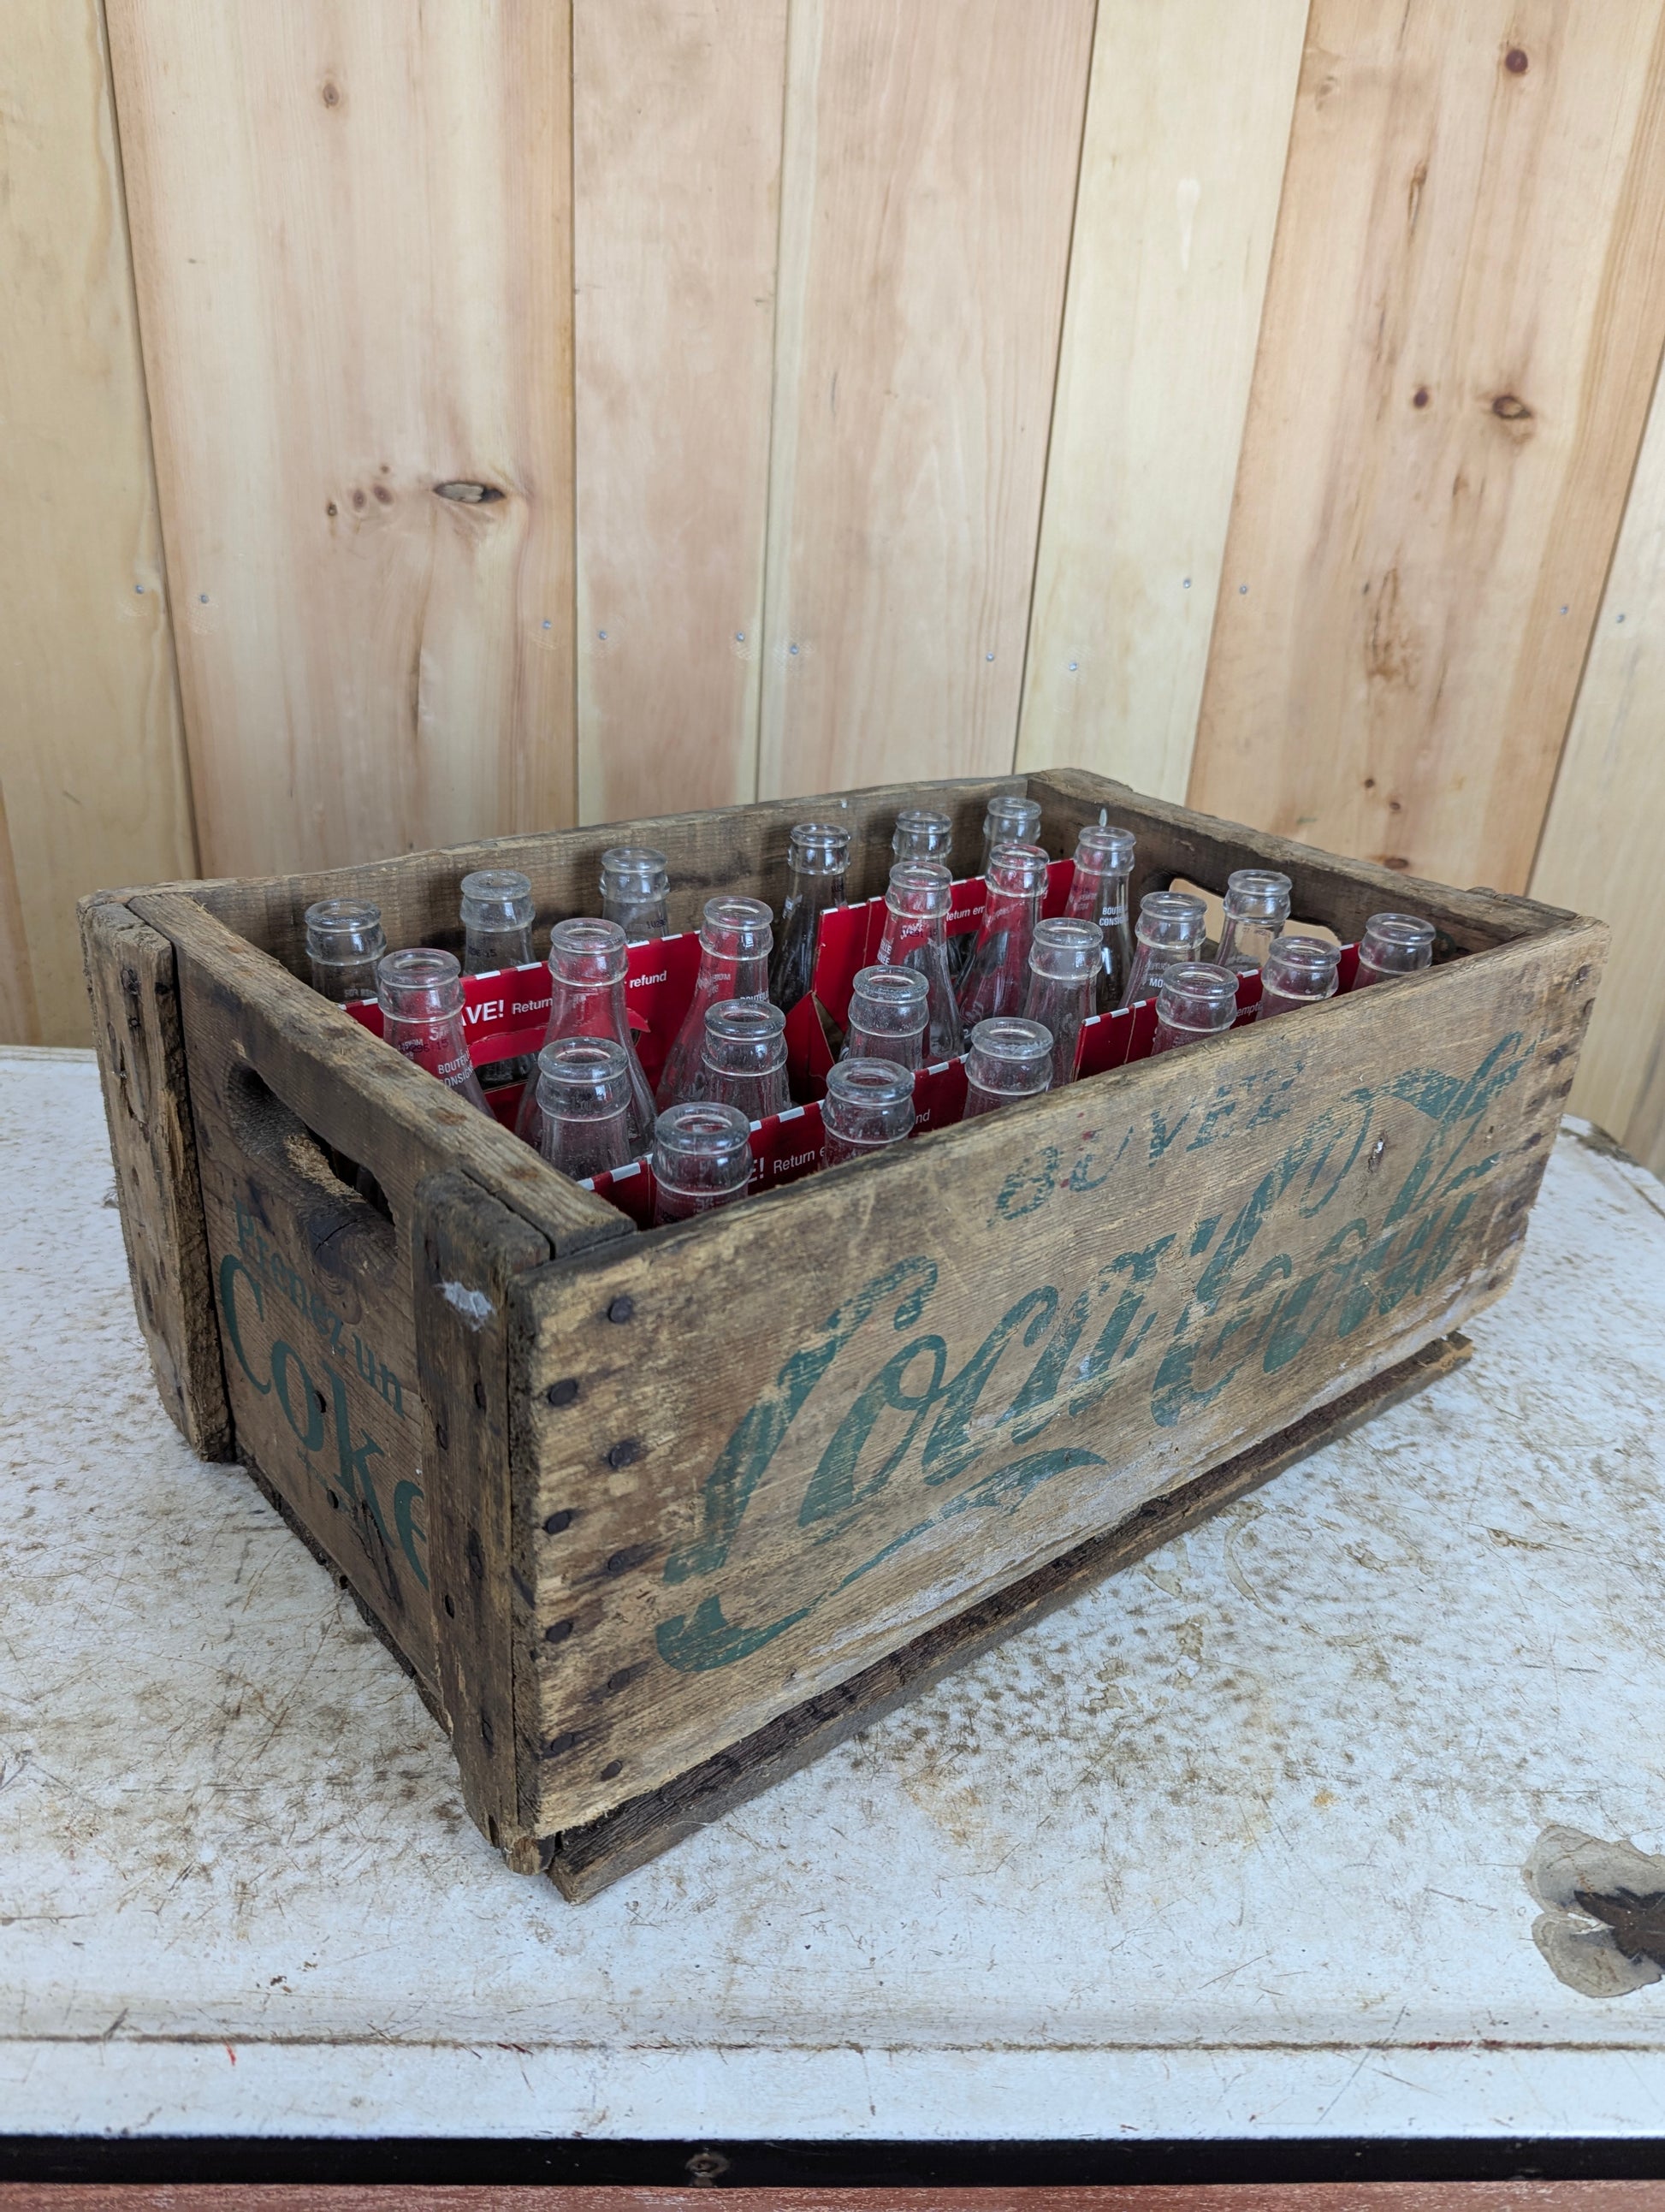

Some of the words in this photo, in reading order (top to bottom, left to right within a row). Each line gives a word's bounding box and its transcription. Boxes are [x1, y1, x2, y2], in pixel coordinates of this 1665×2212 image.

[511, 997, 553, 1015] Return
[629, 970, 667, 989] refund
[773, 1150, 815, 1175] Return
[986, 1059, 1307, 1228] BUVEZ
[234, 1195, 346, 1359] Prenez
[353, 1332, 406, 1420] un
[655, 1030, 1542, 1673] Coca-Cola
